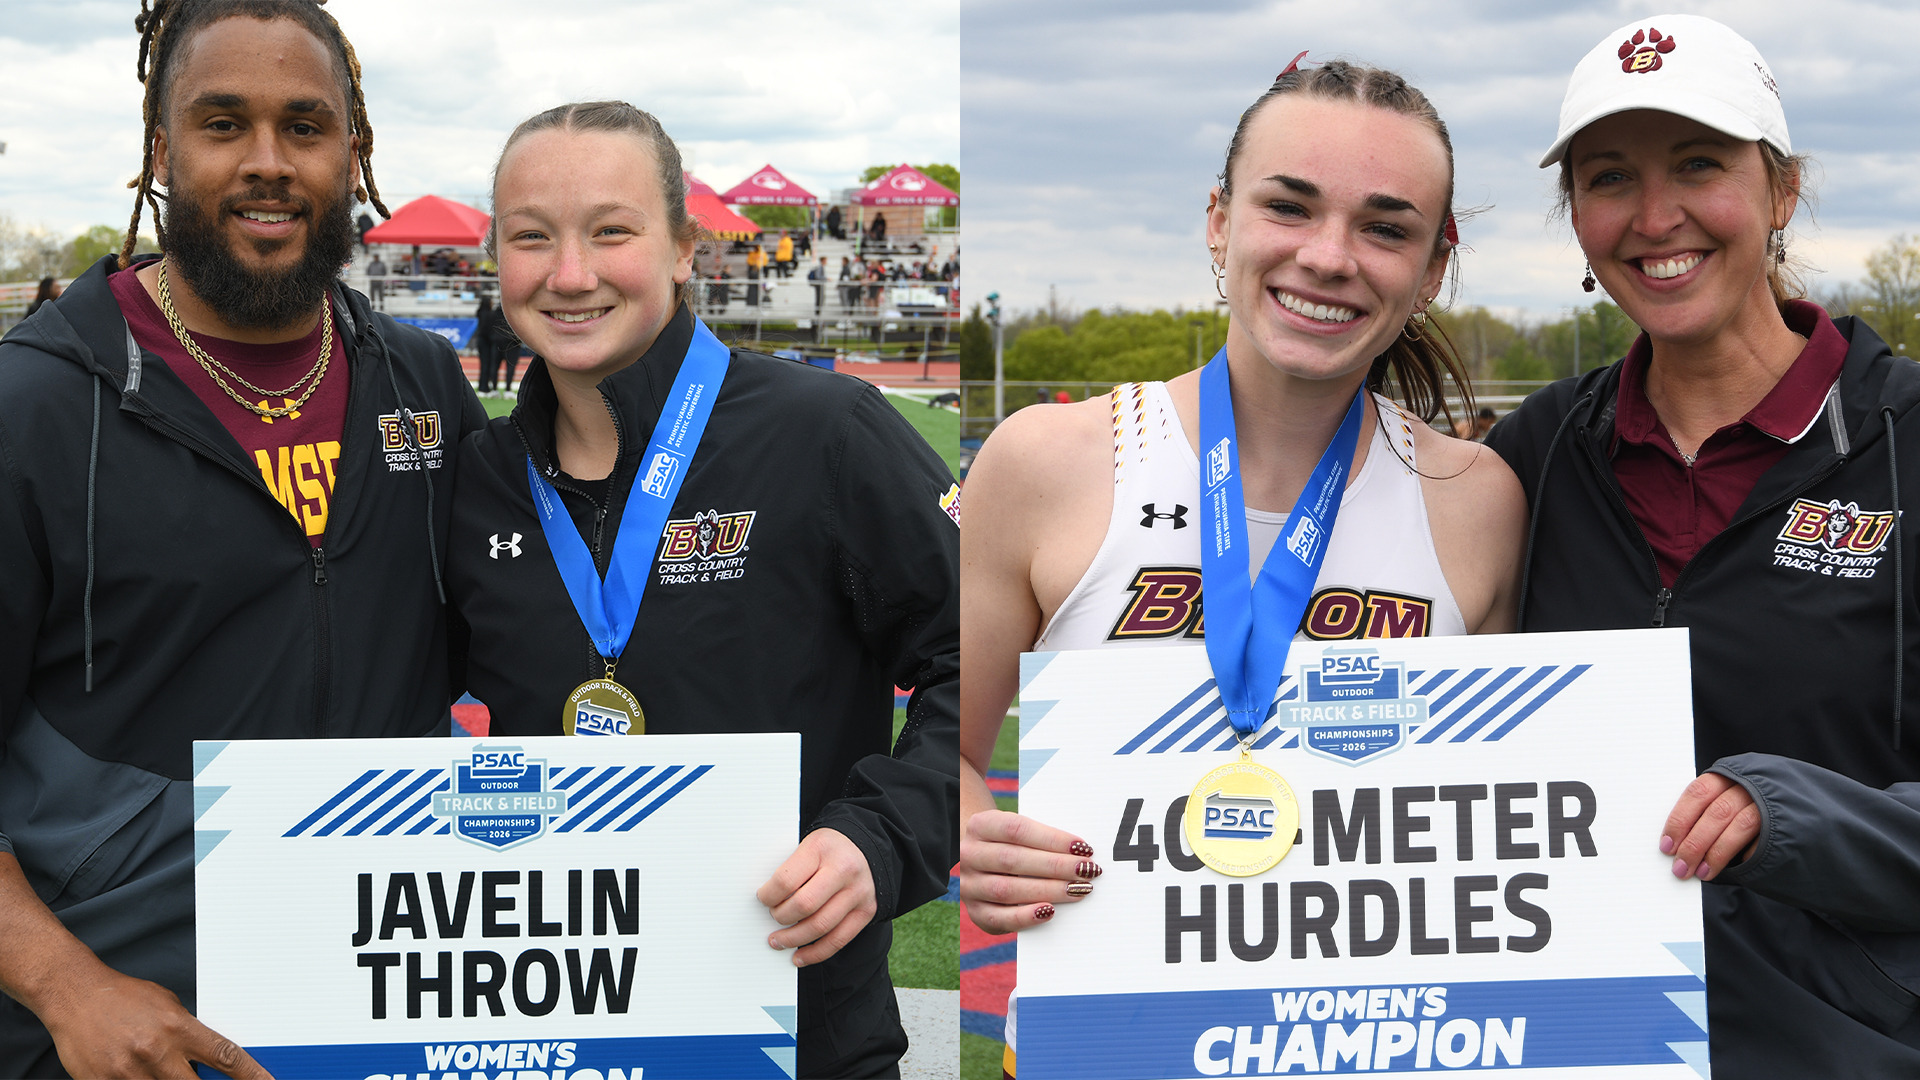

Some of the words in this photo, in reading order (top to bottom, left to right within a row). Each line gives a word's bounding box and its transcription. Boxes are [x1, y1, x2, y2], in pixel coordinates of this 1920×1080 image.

[1630, 51, 1657, 71] B
[667, 401, 689, 446] PENNSYLVANIA
[686, 383, 697, 403] STATE
[674, 420, 690, 448] ATHLETIC
[685, 383, 705, 420] CONFERENCE
[385, 453, 410, 462] CROSS
[410, 449, 443, 461] CONTRY
[388, 463, 413, 472] TRACK
[1213, 443, 1224, 483] PSAC
[648, 455, 673, 495] PSAC
[1220, 487, 1230, 533] PENNSYLVANIA
[659, 511, 756, 561] BU
[1778, 499, 1898, 553] BU
[1293, 521, 1317, 559] PSAC
[658, 562, 697, 574] CROSS
[697, 556, 747, 572] COUNTRY
[1773, 555, 1820, 572] TRACK
[1820, 565, 1833, 575] &
[1836, 568, 1876, 578] FIELD
[1774, 543, 1819, 560] CROSS
[1820, 552, 1882, 567] COUNTRY
[660, 573, 699, 585] TRACK
[701, 572, 710, 582] &
[714, 568, 745, 581] FIELD
[1106, 567, 1434, 641] BOM
[1322, 656, 1380, 673] PSAC
[570, 682, 600, 703] OUTDOOR
[601, 682, 622, 696] TRACK
[626, 697, 640, 718] FIELD
[1332, 688, 1374, 697] OUTDOOR
[577, 710, 628, 736] PSAC
[1290, 705, 1347, 722] TRACK
[1351, 705, 1363, 720] &
[1369, 703, 1417, 719] FIELD
[1314, 728, 1394, 740] CHAMPIONSHIPS
[1342, 742, 1366, 752] 2026
[472, 753, 524, 767] PSAC
[480, 782, 519, 790] OUTDOOR
[442, 797, 493, 812] TRACK
[498, 797, 509, 811] &
[513, 796, 557, 811] FIELD
[464, 819, 535, 828] CHAMPIONSHIPS
[1112, 781, 1598, 872] 40METER
[1205, 807, 1274, 828] PSAC
[489, 830, 511, 838] 2026
[352, 868, 640, 947] JAVELIN
[1164, 872, 1552, 964] HURDLES
[357, 947, 638, 1020] THROW
[1272, 987, 1448, 1023] WOMEN'S
[424, 1042, 577, 1071] WOMEN'S
[1193, 1017, 1527, 1076] CHAMPION
